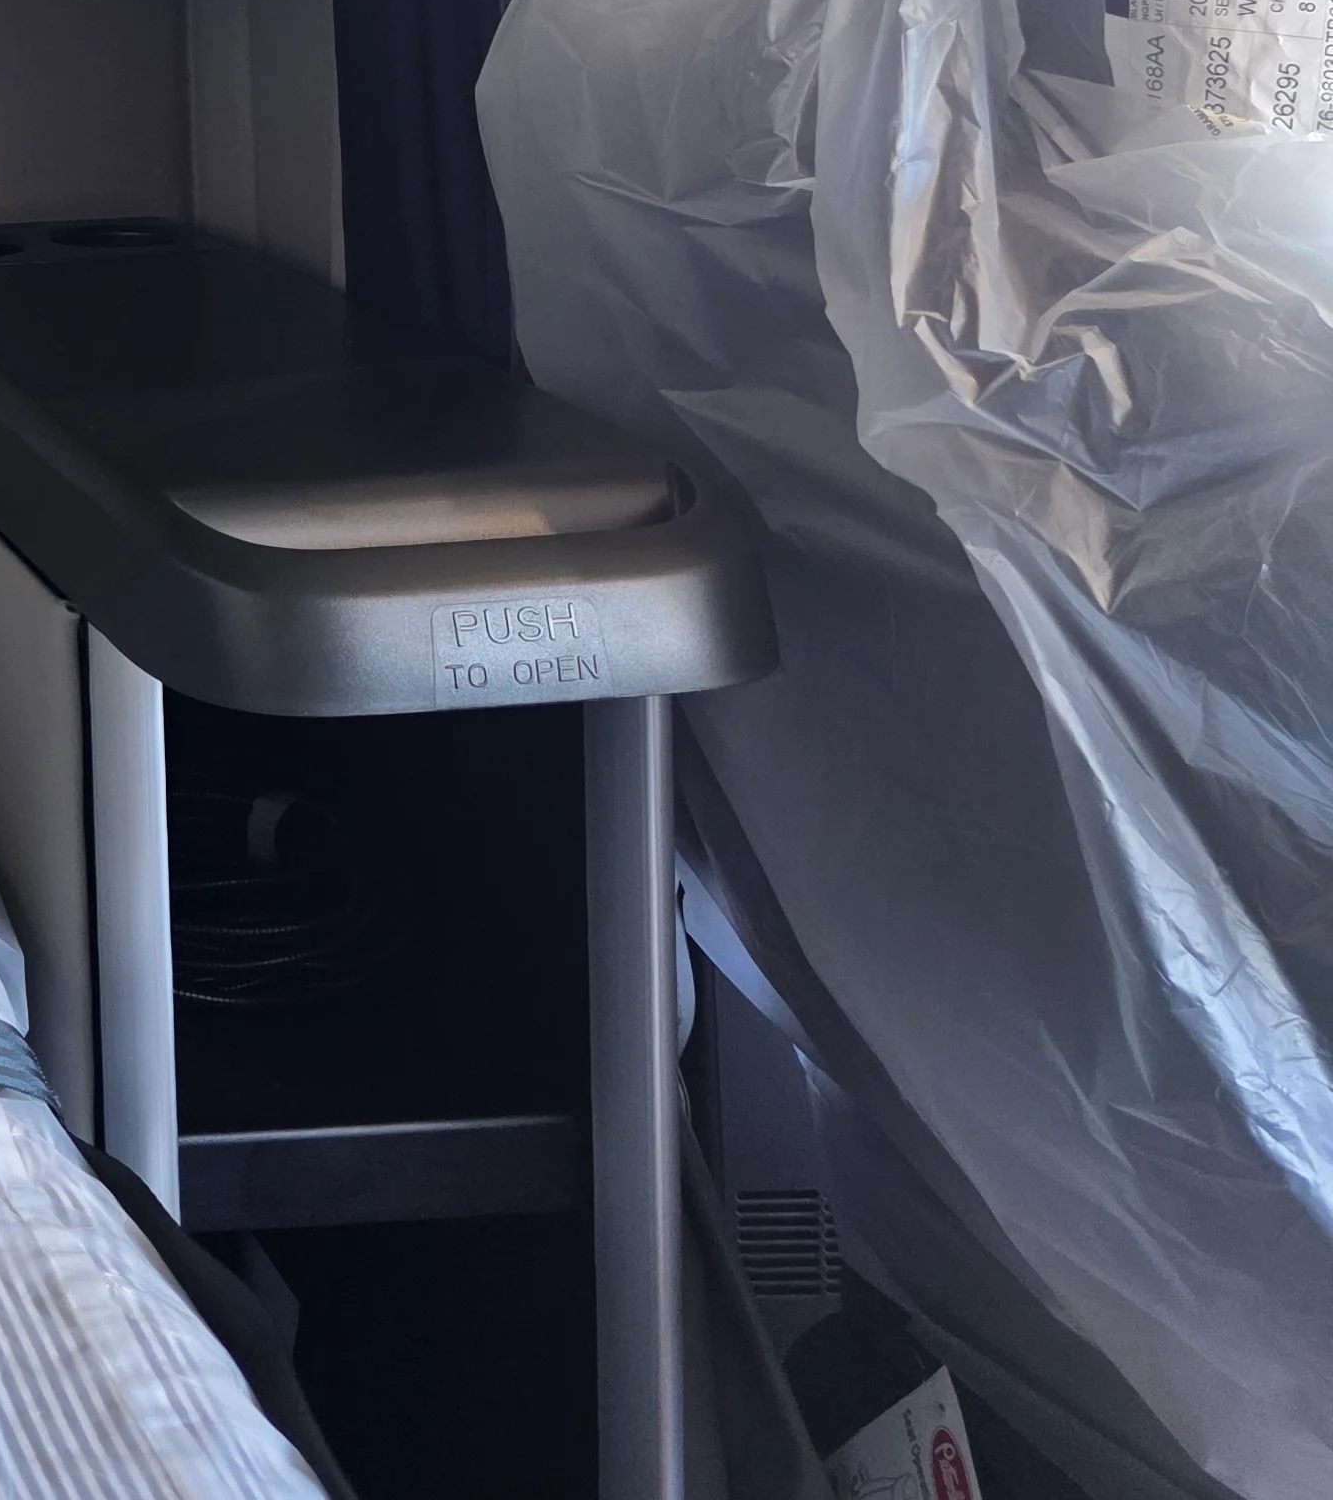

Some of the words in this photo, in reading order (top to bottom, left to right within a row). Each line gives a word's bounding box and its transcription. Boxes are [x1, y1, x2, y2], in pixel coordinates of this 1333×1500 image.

[1272, 63, 1301, 131] 26295
[451, 602, 581, 648] PUSH
[444, 662, 489, 690] TO
[513, 654, 600, 685] OPEN
